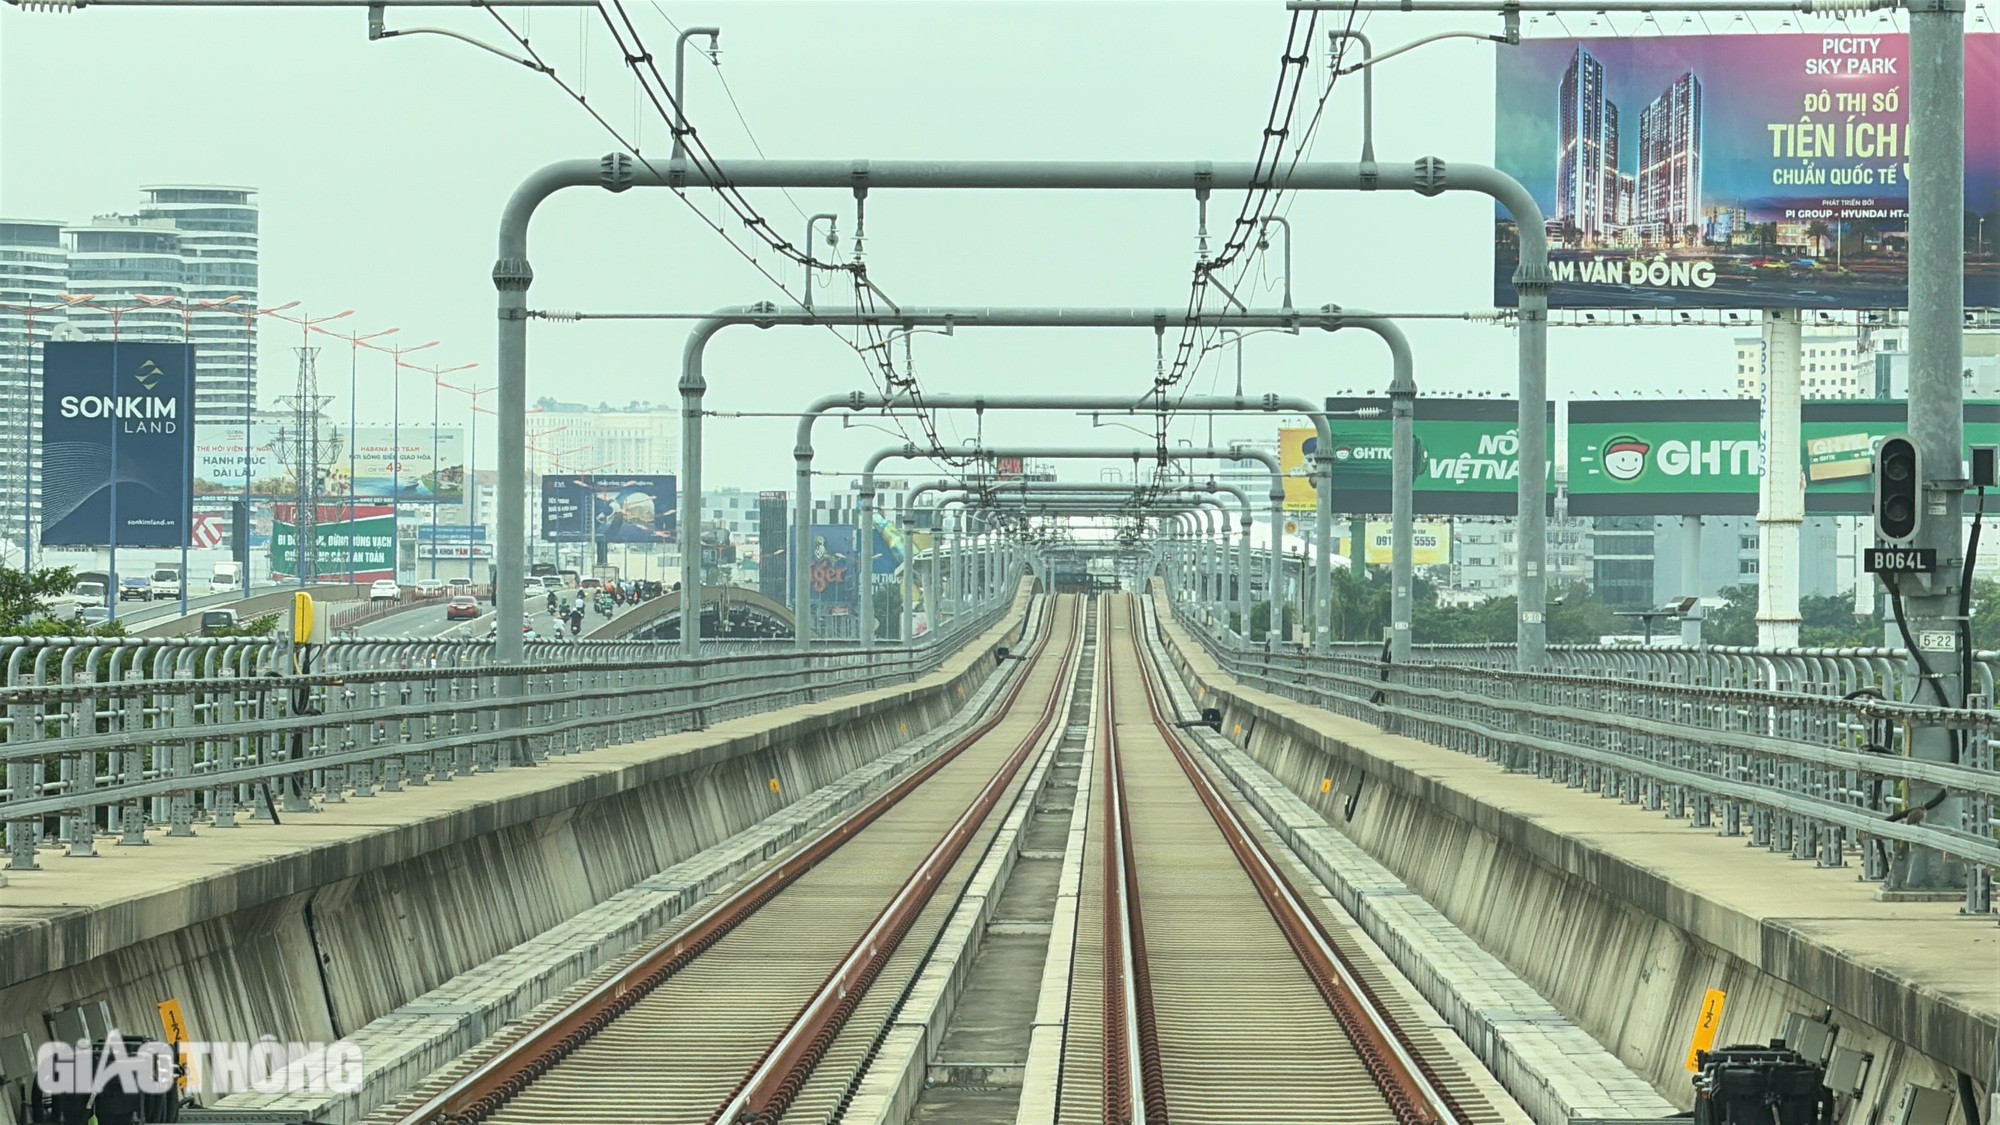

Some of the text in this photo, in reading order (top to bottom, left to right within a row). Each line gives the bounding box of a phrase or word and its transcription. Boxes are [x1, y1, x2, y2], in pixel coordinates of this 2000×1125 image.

[1822, 38, 1881, 54] PICITY
[1805, 58, 1897, 75] SKY PARK
[1803, 86, 1899, 116] ĐÔ THỊ SỐ
[1767, 115, 1835, 165] TIỆN
[1846, 115, 1897, 157] ÍCH
[1772, 162, 1898, 185] CHUẨN QUỐC TẾ
[1785, 209, 1795, 218] PI
[1798, 209, 1833, 219] GROUP
[1841, 209, 1887, 219] HYUNDAI
[1579, 255, 1623, 284] VĂN
[1629, 252, 1717, 288] ĐỒNG
[60, 395, 176, 419] SONKIM
[124, 421, 176, 434] LAND
[372, 536, 392, 549] VẠCH
[352, 551, 364, 563] AN
[365, 550, 385, 563] TOÀN
[1874, 552, 1927, 569] B064L
[1923, 635, 1951, 647] 5-22
